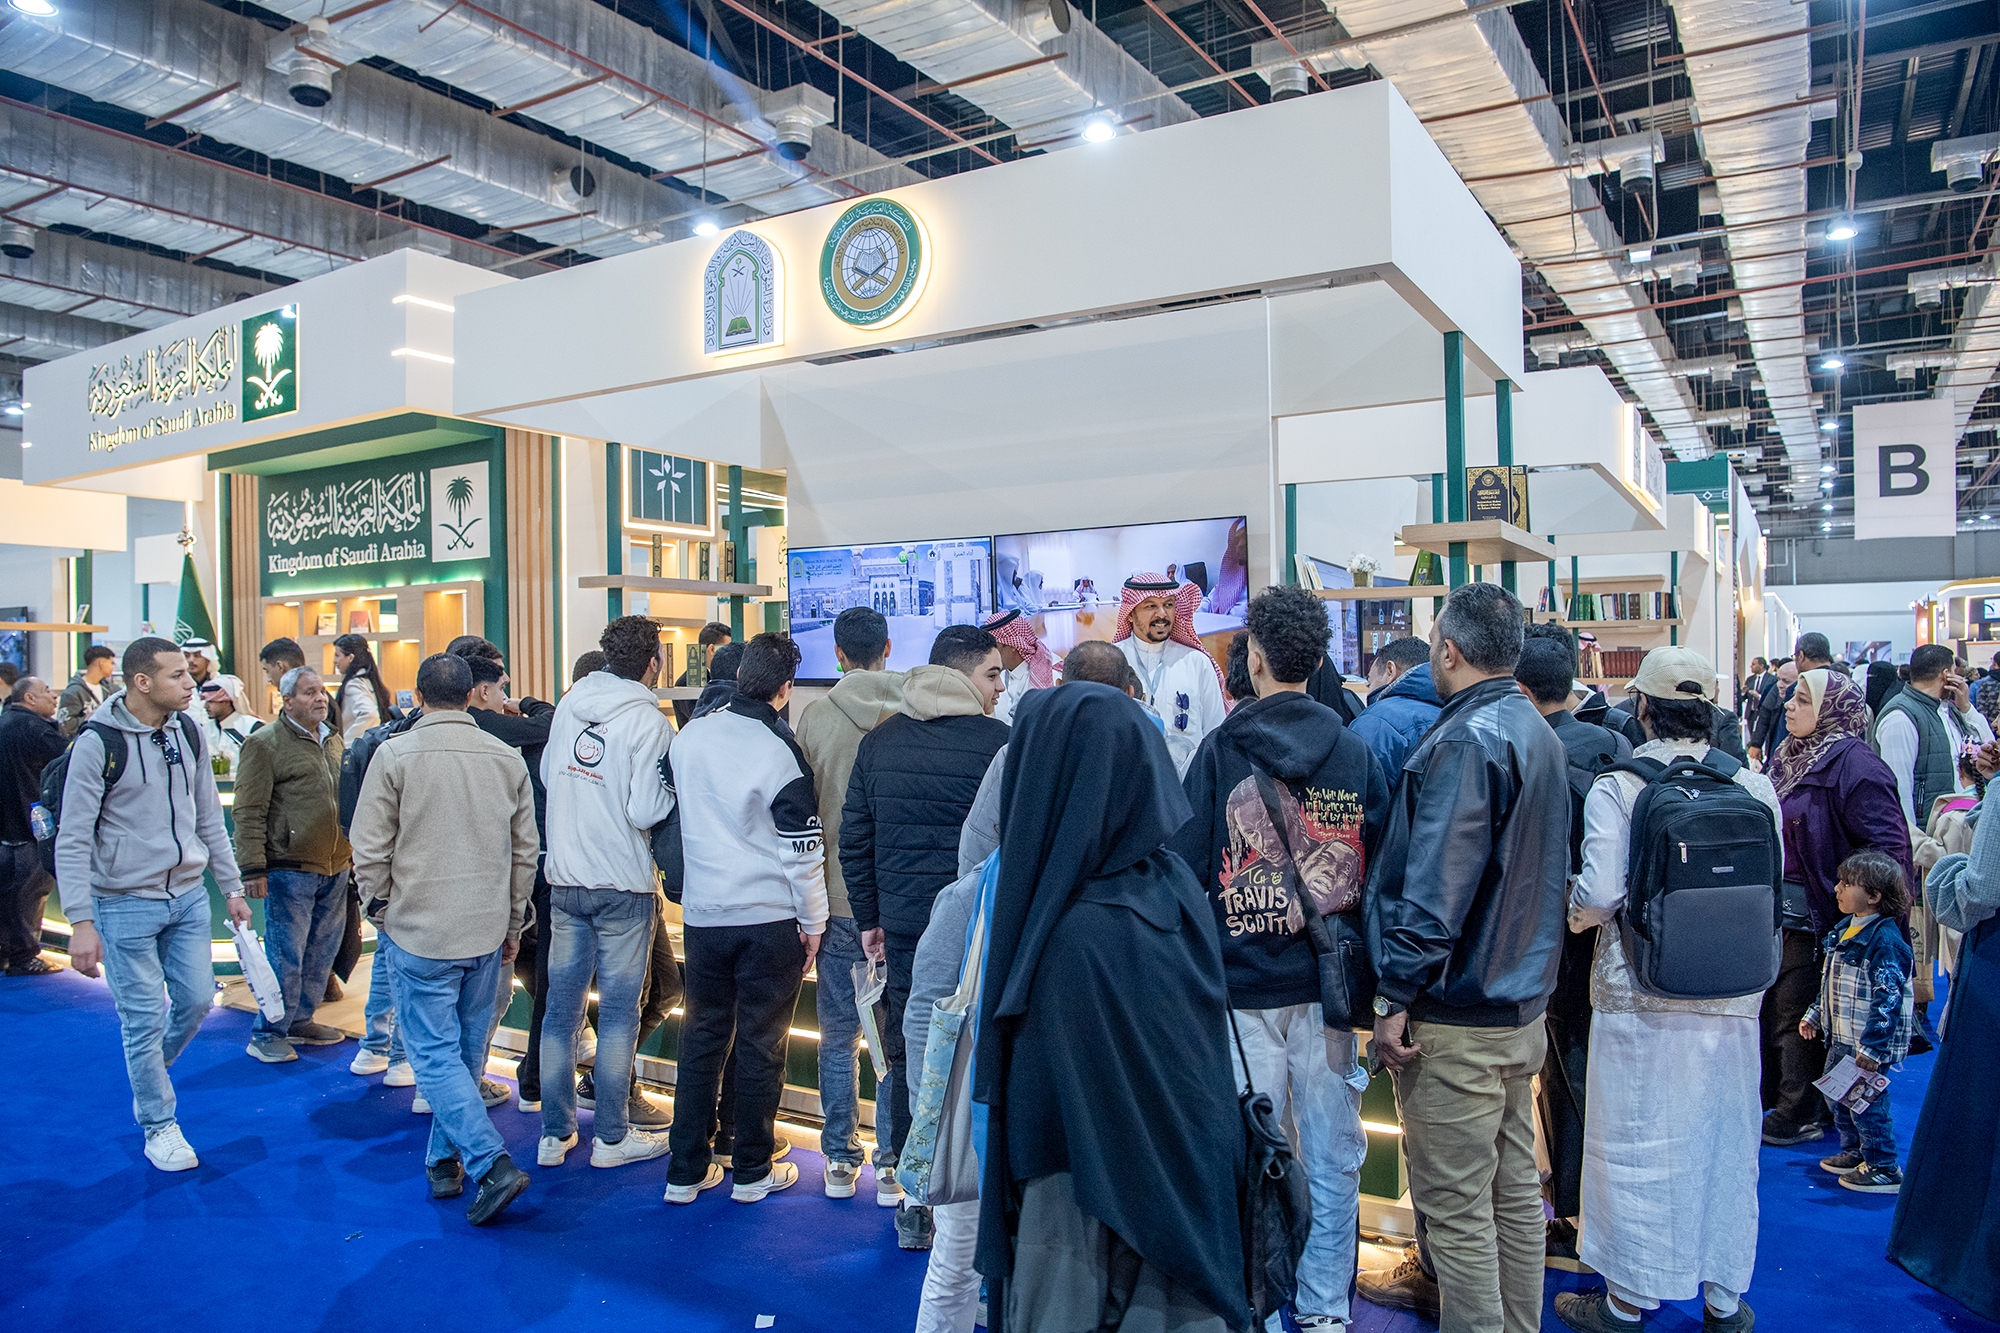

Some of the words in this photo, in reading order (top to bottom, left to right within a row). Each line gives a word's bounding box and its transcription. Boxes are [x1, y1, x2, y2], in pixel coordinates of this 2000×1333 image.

[88, 425, 140, 452] Kingdom
[142, 418, 154, 439] of
[156, 408, 192, 436] Saudi
[193, 399, 237, 428] Arabia
[1878, 444, 1930, 497] B
[267, 485, 338, 547] السعودية
[268, 551, 323, 577] Kingdom
[324, 547, 338, 567] of
[340, 543, 378, 566] Saudi
[380, 538, 426, 562] Arabia
[1305, 786, 1322, 800] You
[1342, 813, 1364, 824] trying
[792, 838, 823, 853] MO
[1218, 885, 1289, 915] TRAVIS
